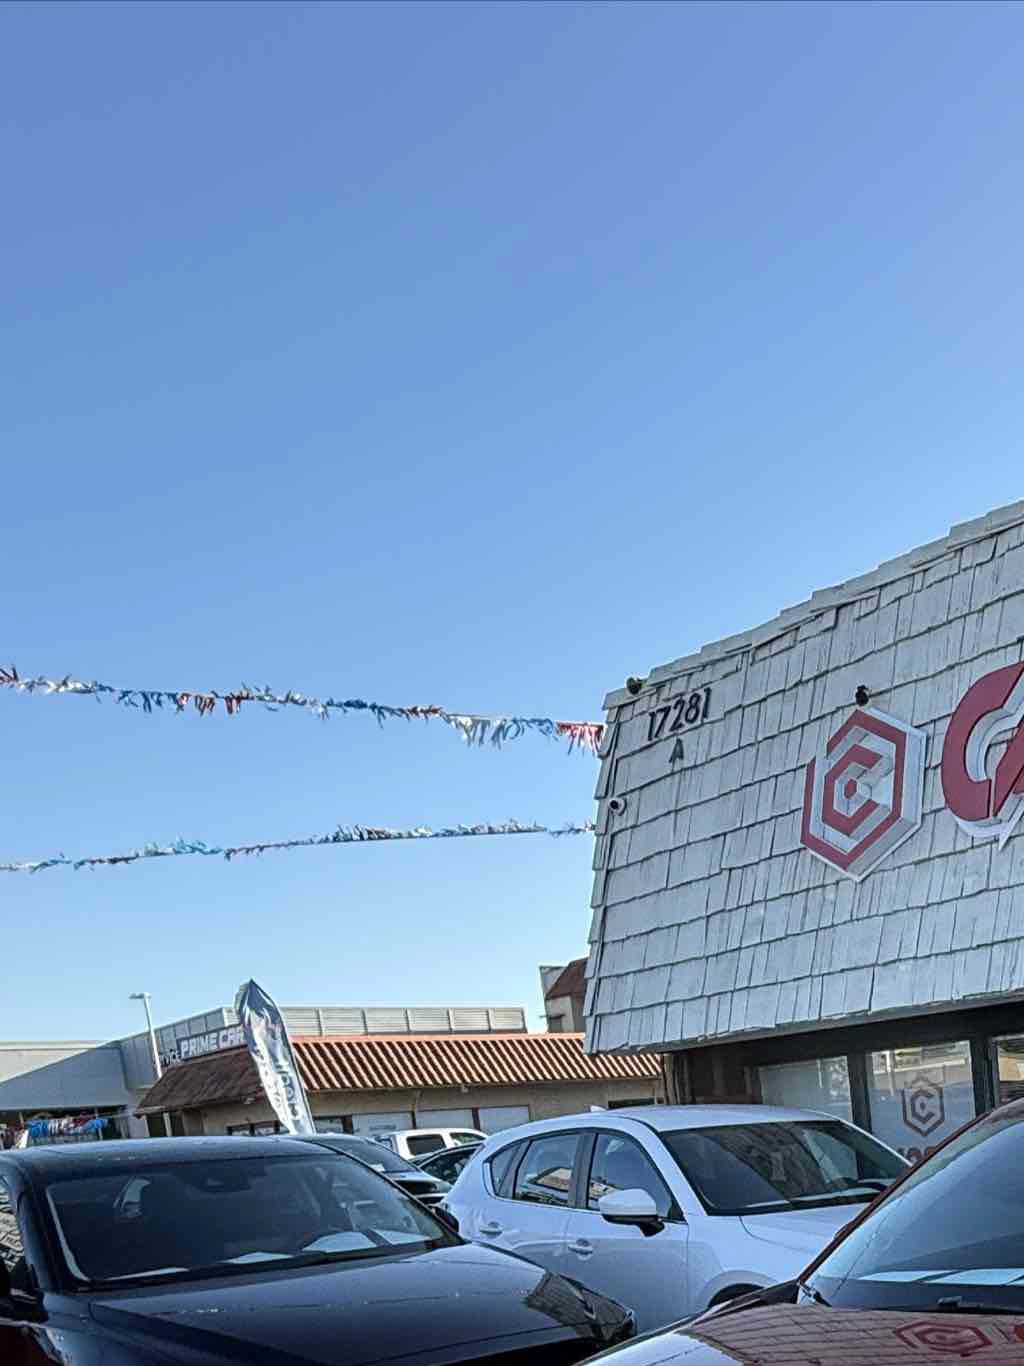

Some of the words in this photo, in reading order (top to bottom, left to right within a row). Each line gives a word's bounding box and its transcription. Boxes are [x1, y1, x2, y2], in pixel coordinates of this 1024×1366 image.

[647, 687, 712, 741] 17281
[669, 738, 684, 763] A
[180, 1031, 218, 1058] PRIME
